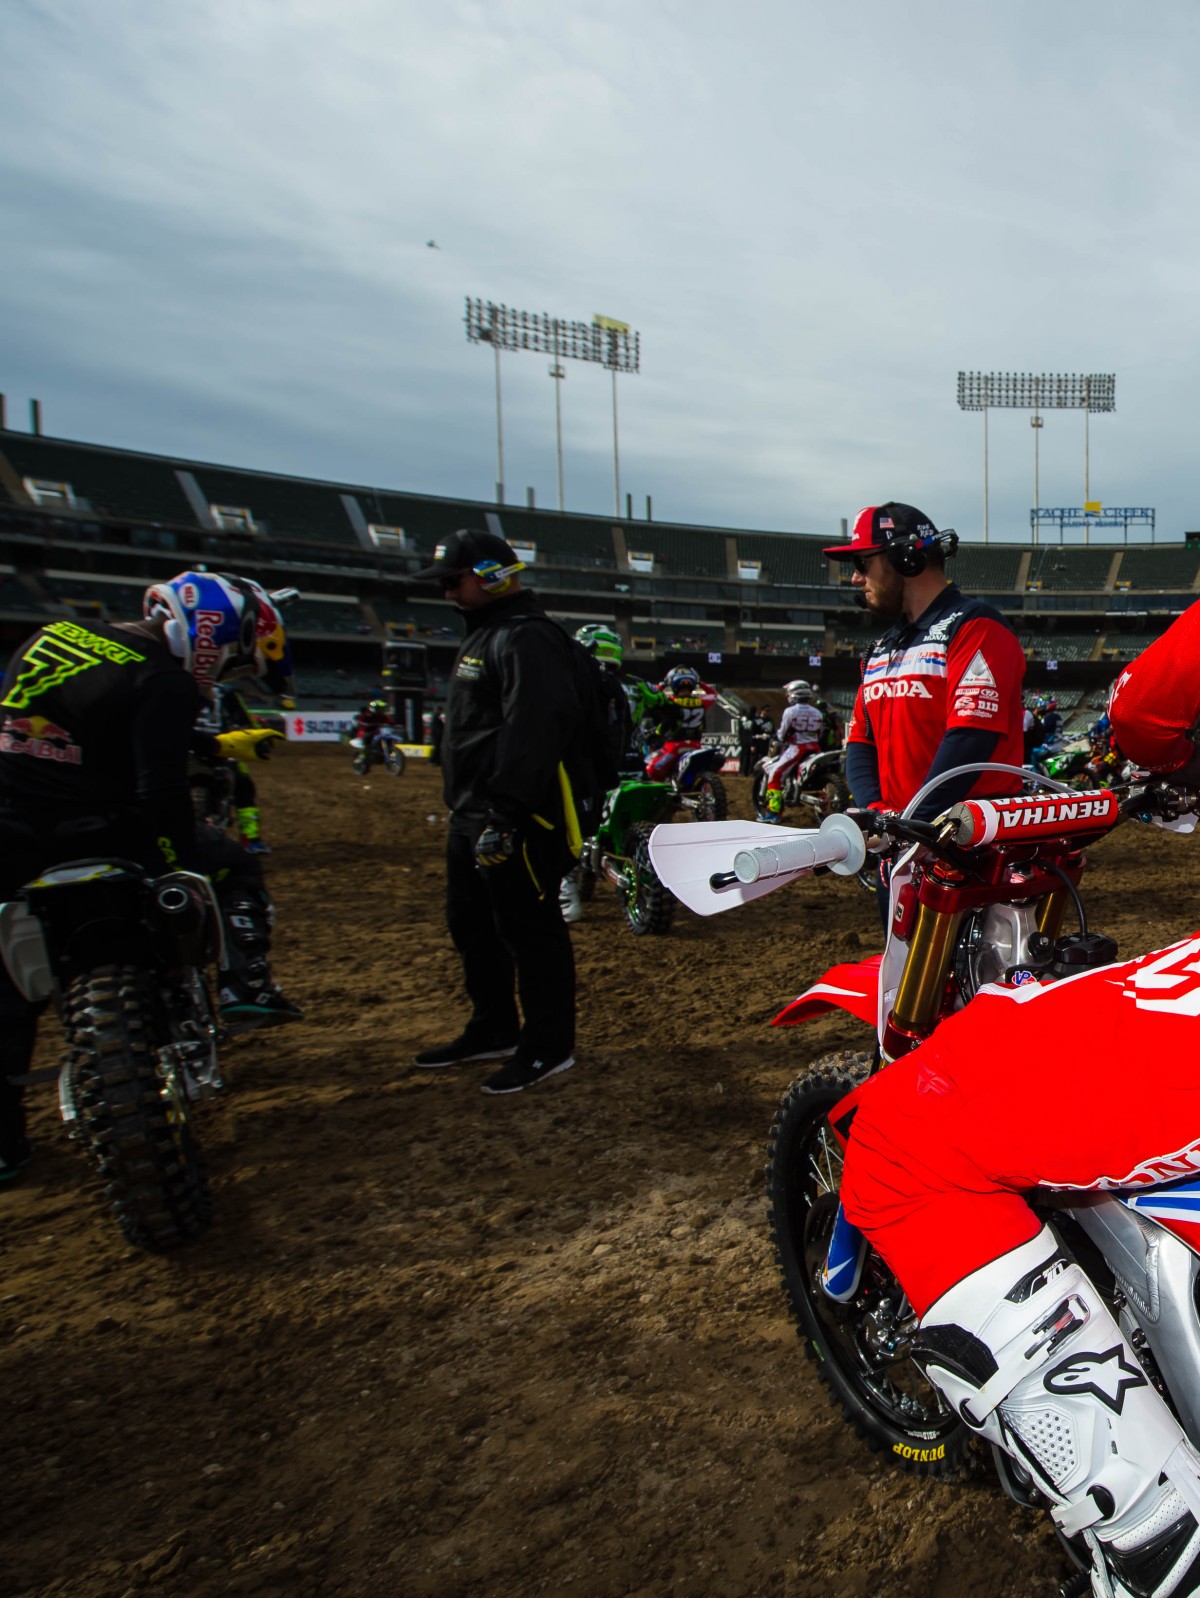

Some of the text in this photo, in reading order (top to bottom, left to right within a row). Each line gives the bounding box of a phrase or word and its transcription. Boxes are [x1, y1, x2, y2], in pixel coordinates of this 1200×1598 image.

[1103, 507, 1149, 518] CREEK
[42, 621, 147, 665] STEWART
[195, 609, 224, 650] Red
[0, 635, 102, 709] 7
[794, 715, 821, 732] 55
[33, 738, 82, 765] Bull
[998, 799, 1110, 829] RENTHA
[1015, 970, 1032, 986] VP
[892, 1442, 946, 1462] DUNLOP
